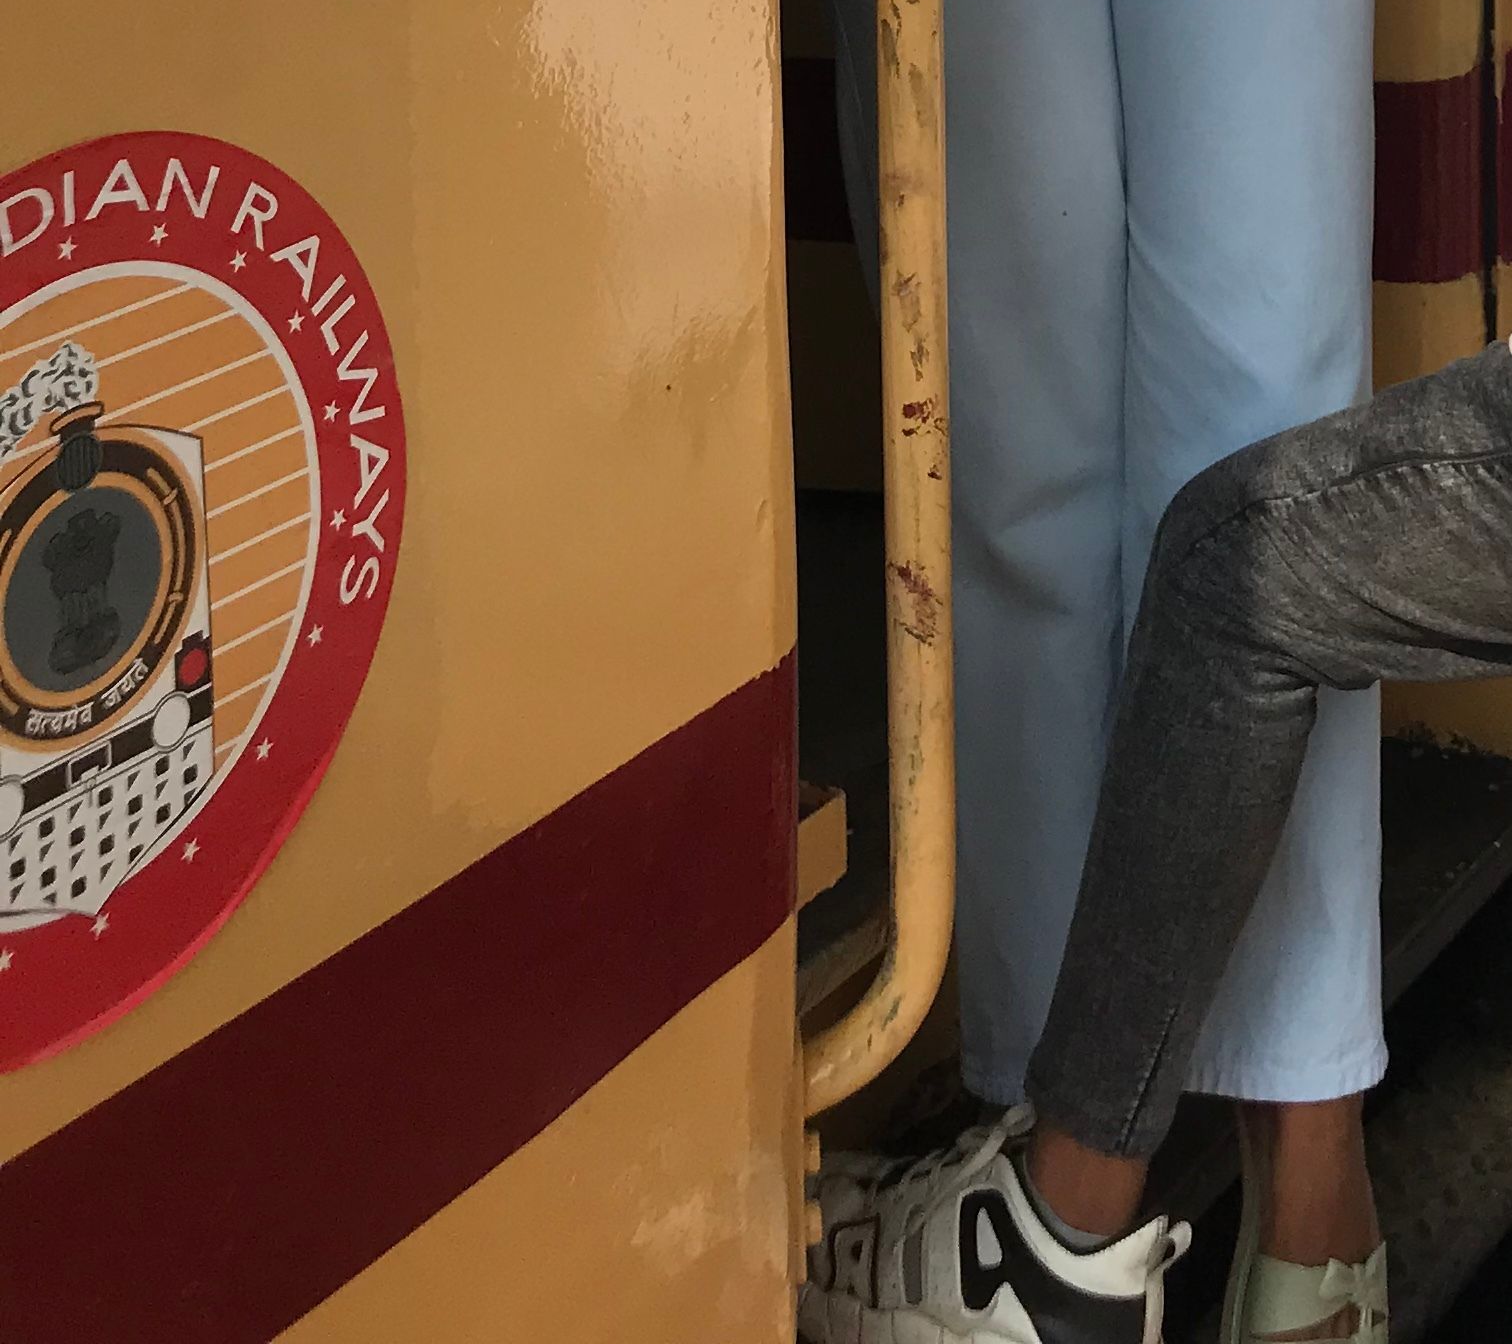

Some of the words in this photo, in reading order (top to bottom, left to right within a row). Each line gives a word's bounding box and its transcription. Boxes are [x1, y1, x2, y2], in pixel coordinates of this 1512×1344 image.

[230, 181, 392, 606] RAILWAYS
[25, 700, 95, 735] सत्यमेव
[100, 657, 149, 708] जयते
